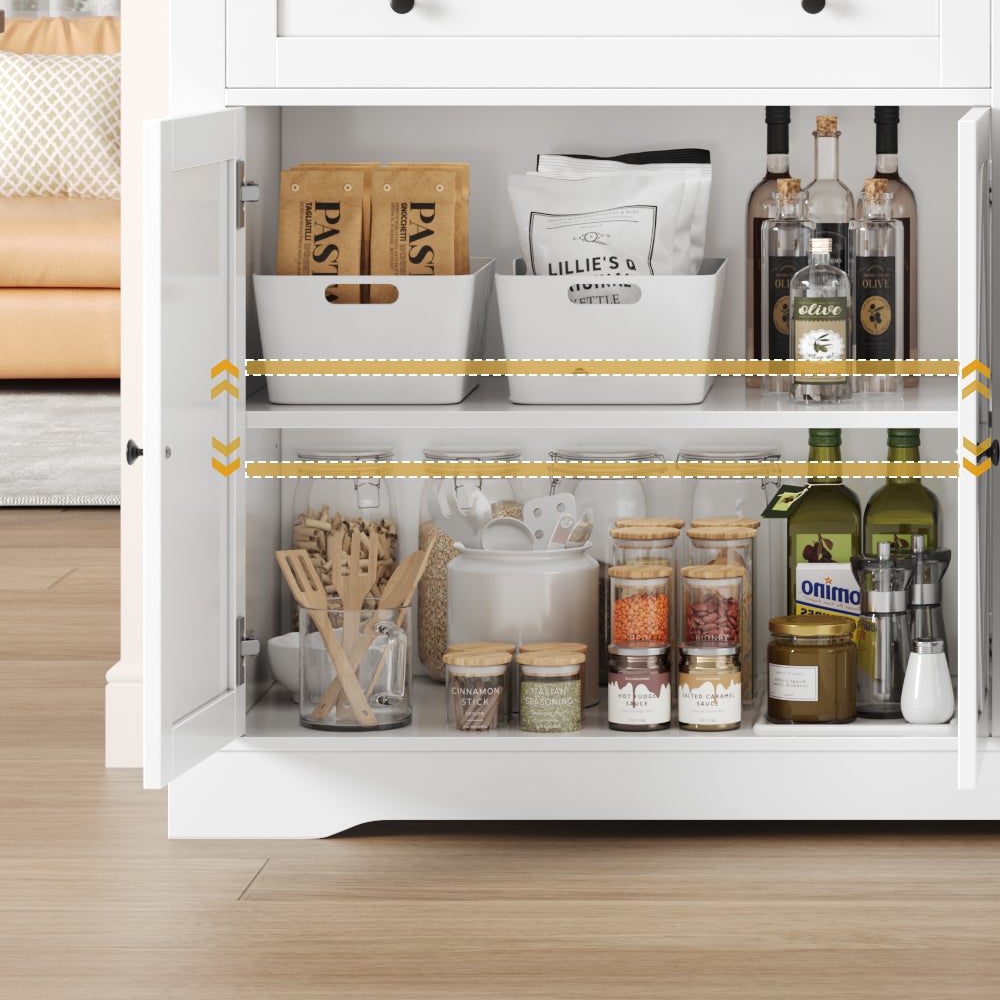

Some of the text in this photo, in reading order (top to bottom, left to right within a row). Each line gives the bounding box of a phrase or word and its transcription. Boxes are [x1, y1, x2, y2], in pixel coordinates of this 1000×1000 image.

[399, 202, 408, 242] GNOCCHETTI
[408, 200, 436, 276] PAST
[548, 256, 637, 276] LILLIE'S Q
[774, 279, 790, 289] OLI
[862, 279, 890, 289] OLIVE
[798, 303, 843, 316] olive
[451, 687, 500, 696] CINNAMON
[530, 687, 568, 696] ITALIAN
[461, 698, 489, 706] STICK
[525, 698, 574, 706] SEASONING
